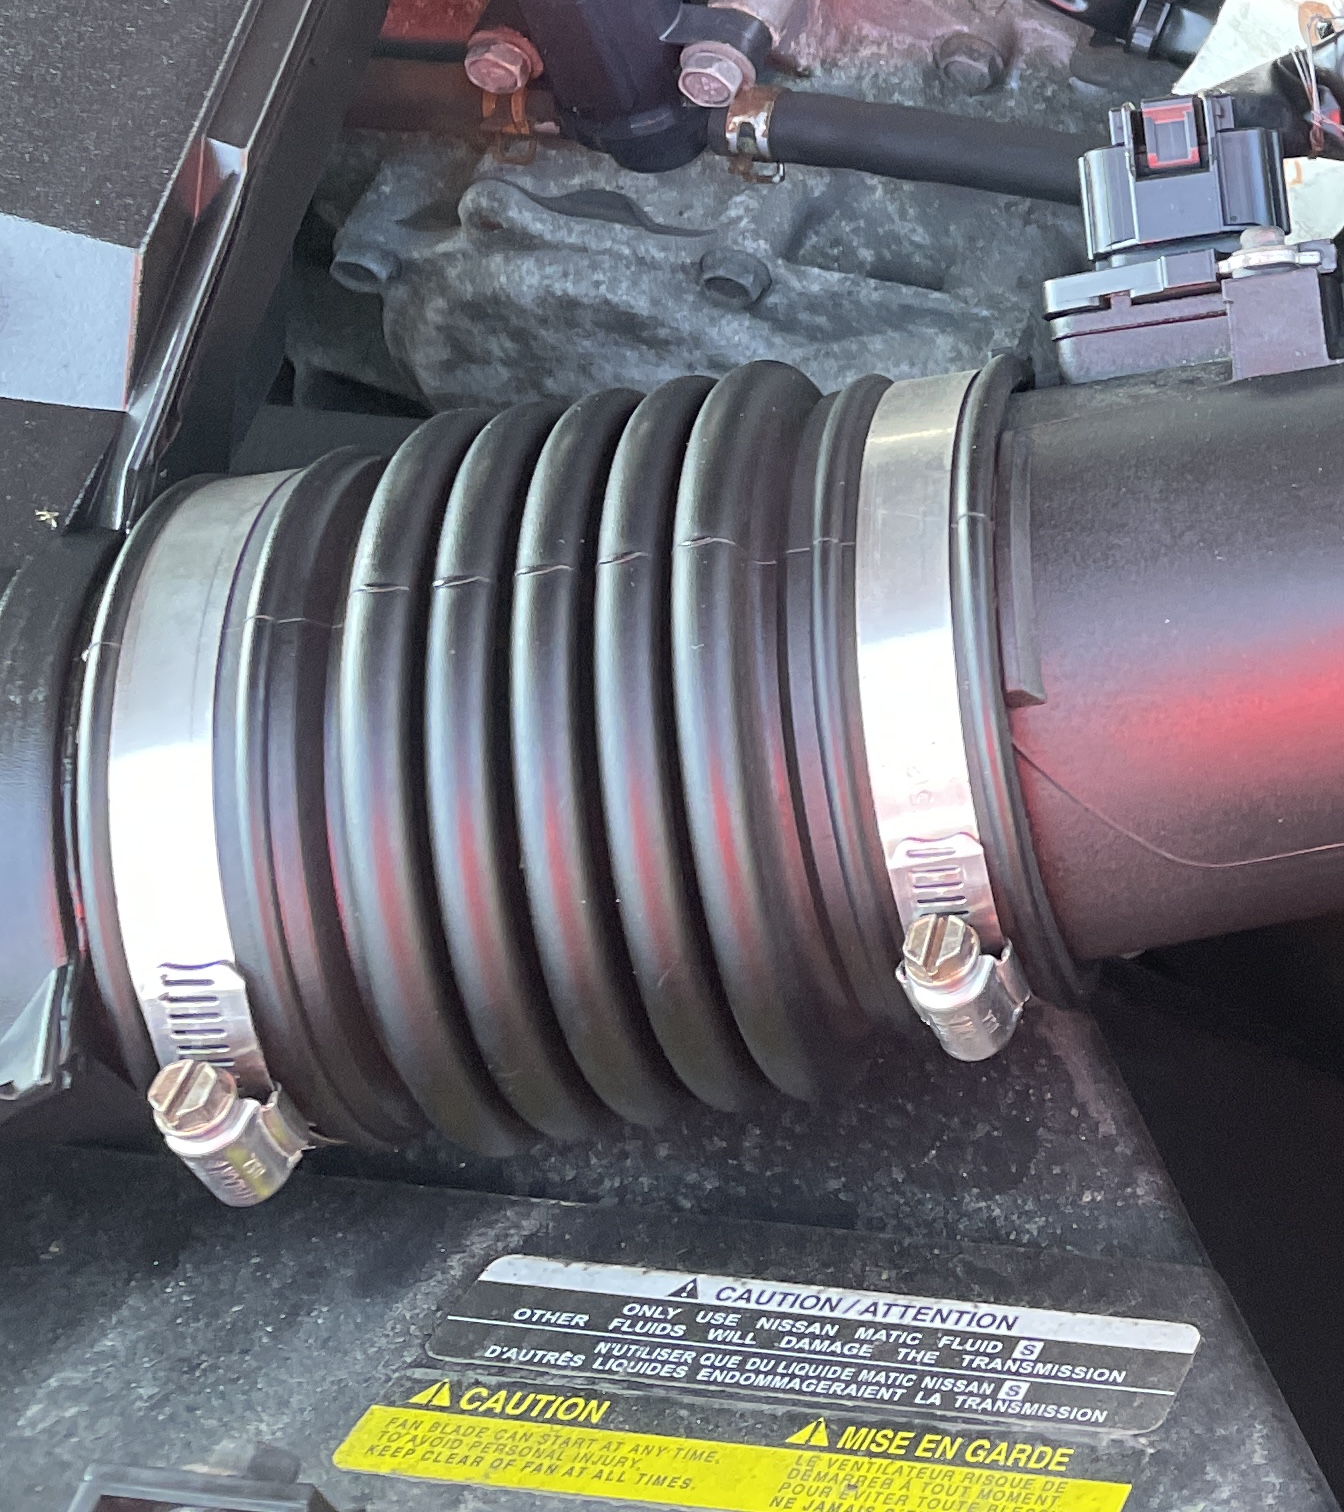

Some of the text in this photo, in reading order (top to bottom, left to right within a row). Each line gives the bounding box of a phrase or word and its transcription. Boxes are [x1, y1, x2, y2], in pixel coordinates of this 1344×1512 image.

[512, 1307, 1128, 1385] OTHER FLUIDS WILL DAMAGE THE TRANSMISSION
[621, 1302, 683, 1321] ONLY
[695, 1310, 742, 1328] USE
[755, 1316, 840, 1338] NISSAN
[852, 1326, 923, 1347] MATIC
[938, 1334, 1004, 1355] FLUID
[592, 1356, 690, 1379] LIQUIDES
[696, 1369, 908, 1403] ENDOMMAGERAIENT
[913, 1391, 942, 1407] LA
[953, 1395, 1108, 1424] TRANSMISSION
[699, 1352, 742, 1370] QUE
[746, 1356, 776, 1373] DU
[777, 1361, 856, 1382] LIQUIDE
[857, 1369, 917, 1388] MATIC
[920, 1375, 996, 1396] NISSAN
[459, 1387, 611, 1425] CAUTION
[377, 1430, 404, 1444] TO
[404, 1434, 463, 1451] AVOID
[467, 1440, 565, 1463] PERSONAL
[384, 1416, 424, 1432] FAN
[427, 1421, 490, 1439] BLADE
[493, 1428, 534, 1444] CAN
[536, 1433, 599, 1451] START
[600, 1441, 626, 1453] AT
[628, 1444, 670, 1458] ANY
[835, 1426, 1075, 1473] MISE EN GARDE
[364, 1444, 416, 1460] KEEP
[420, 1450, 485, 1468] CLEAR
[488, 1457, 517, 1471] OF
[519, 1460, 559, 1476] FAN
[561, 1465, 588, 1479] AT
[590, 1468, 627, 1484] ALL
[795, 1453, 1069, 1495] LE VENTILATEUR RISQUE DE
[768, 1495, 798, 1510] NE
[777, 1481, 833, 1499] POUR
[920, 1481, 973, 1498] TOUT
